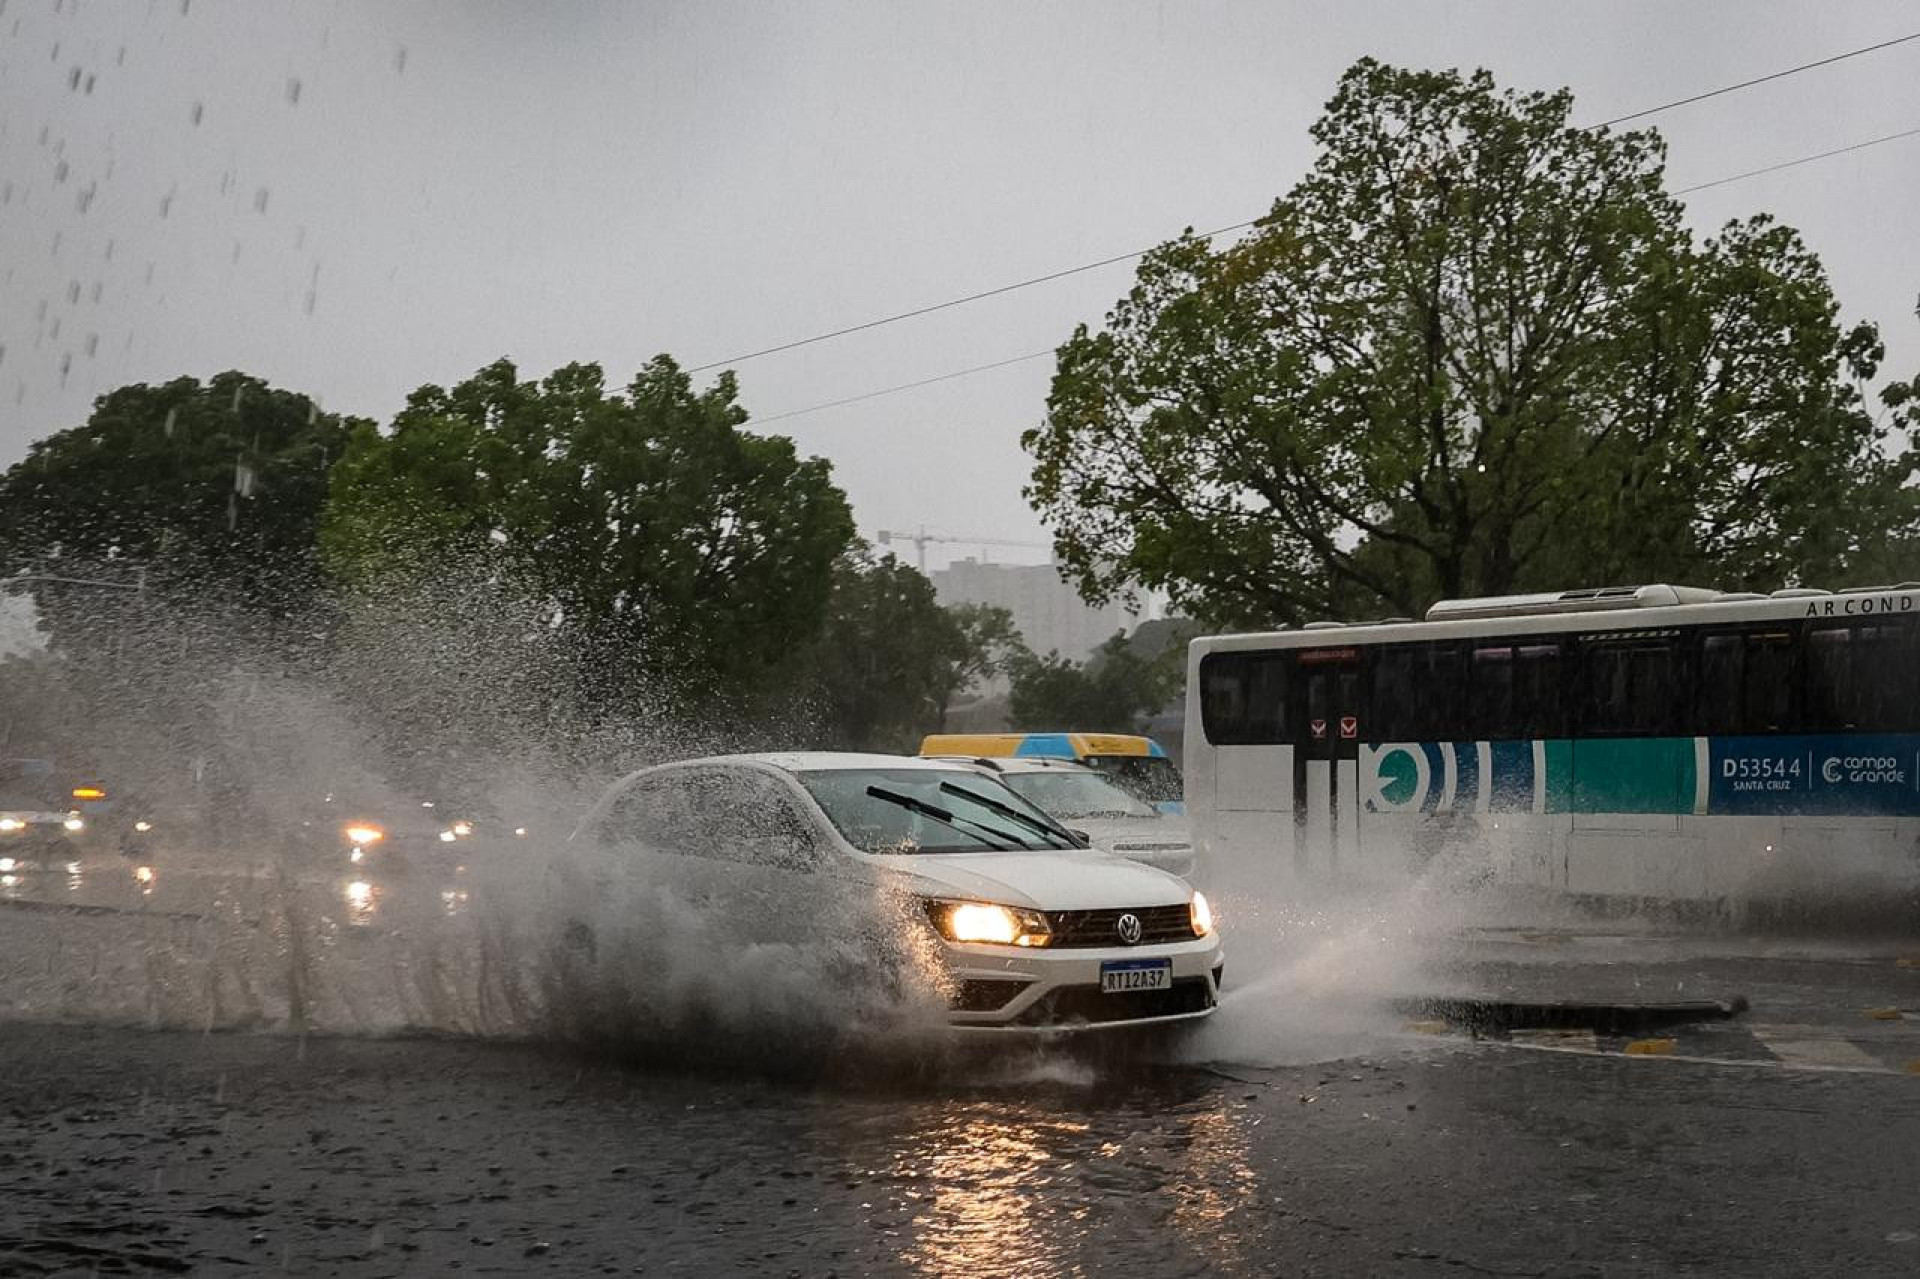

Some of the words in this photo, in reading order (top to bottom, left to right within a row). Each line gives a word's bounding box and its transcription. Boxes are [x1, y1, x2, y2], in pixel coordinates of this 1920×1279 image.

[1806, 600, 1834, 616] AR
[1723, 758, 1800, 777] D53544
[1733, 781, 1764, 790] SANTA
[1766, 780, 1791, 790] CRUZ
